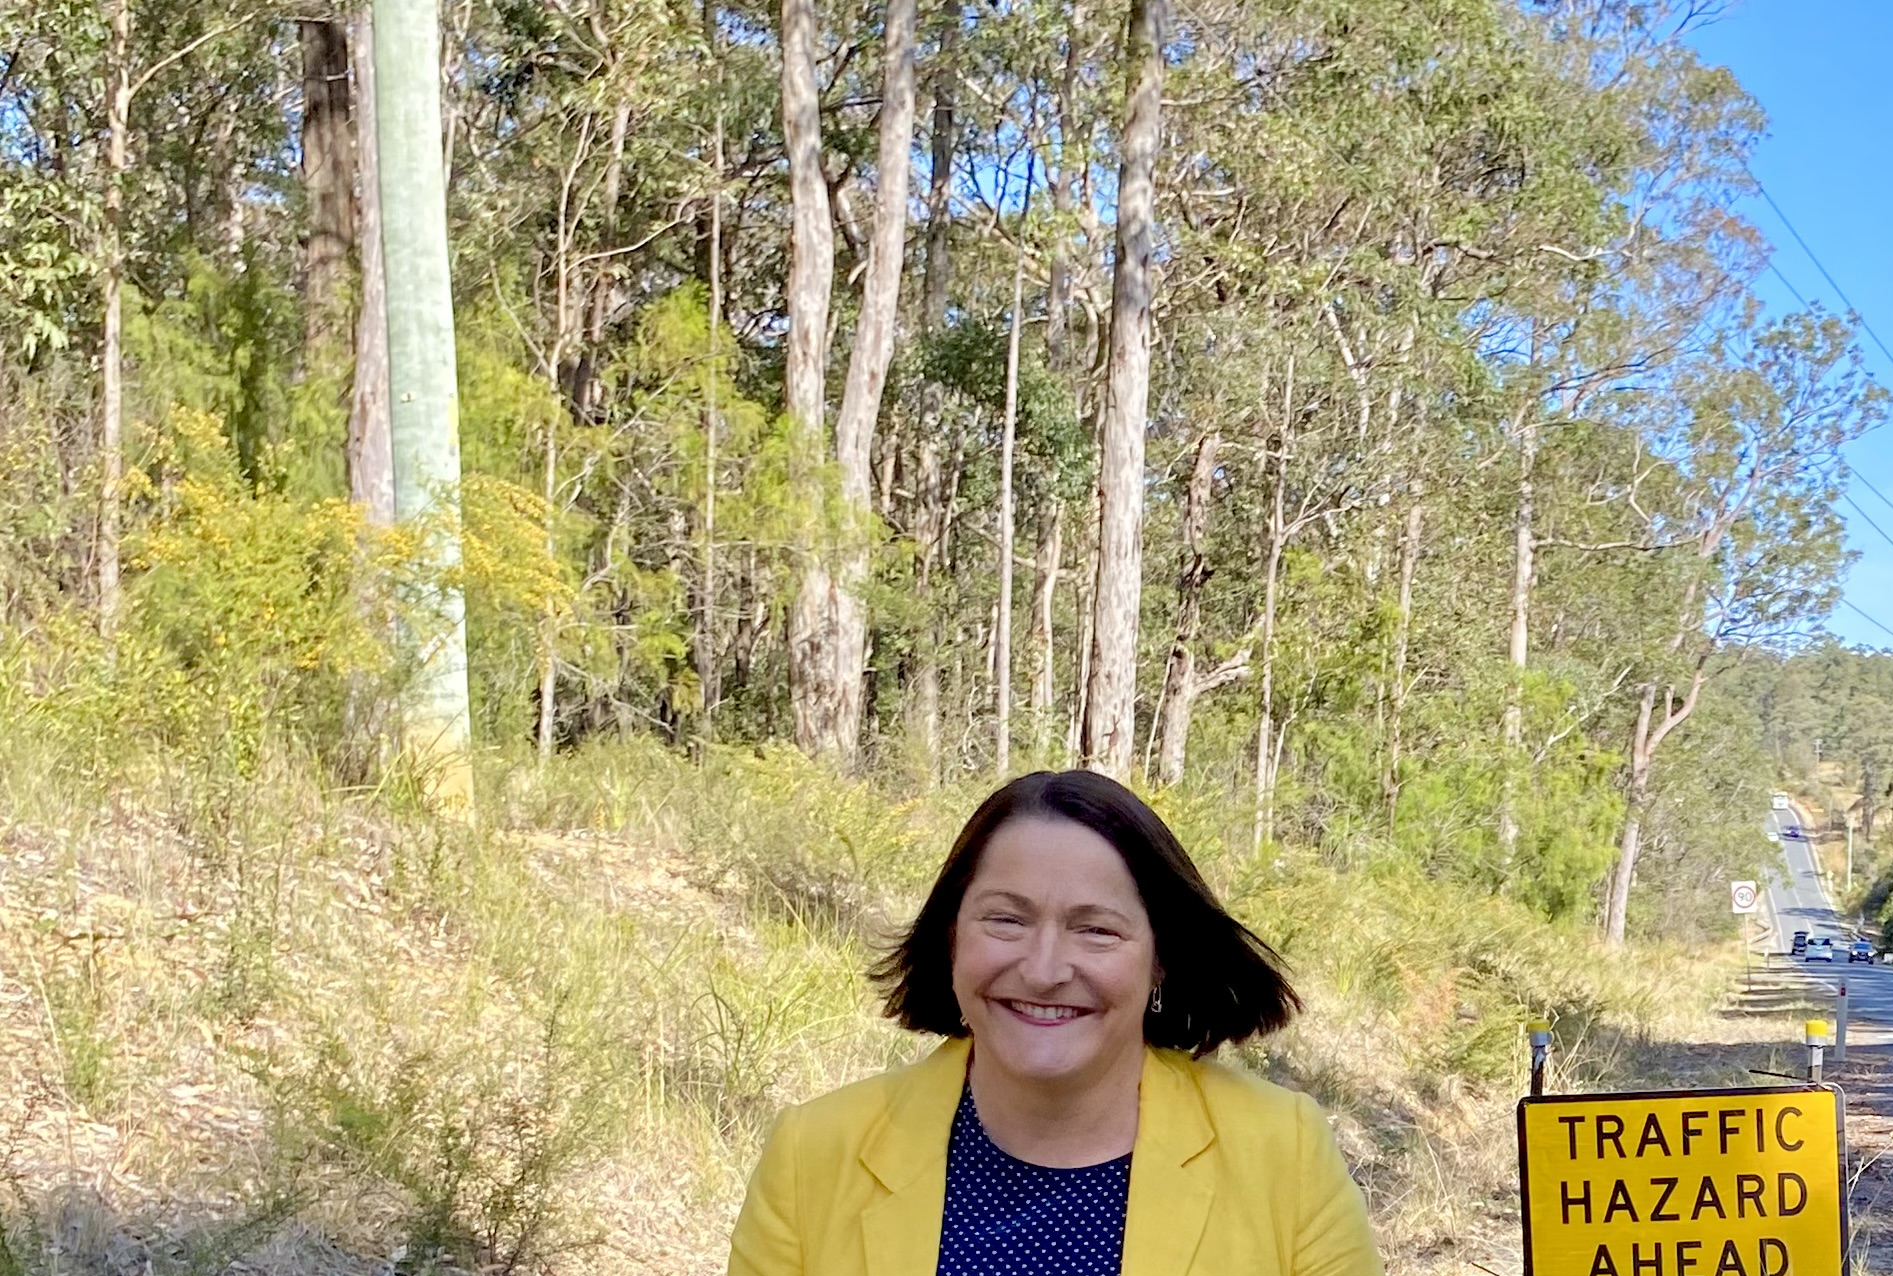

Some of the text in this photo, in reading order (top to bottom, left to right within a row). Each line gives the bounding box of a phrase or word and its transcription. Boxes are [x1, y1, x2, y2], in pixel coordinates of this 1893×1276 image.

[1738, 892, 1752, 902] 90
[1558, 1107, 1805, 1160] TRAFFIC
[1560, 1172, 1808, 1225] HAZARD
